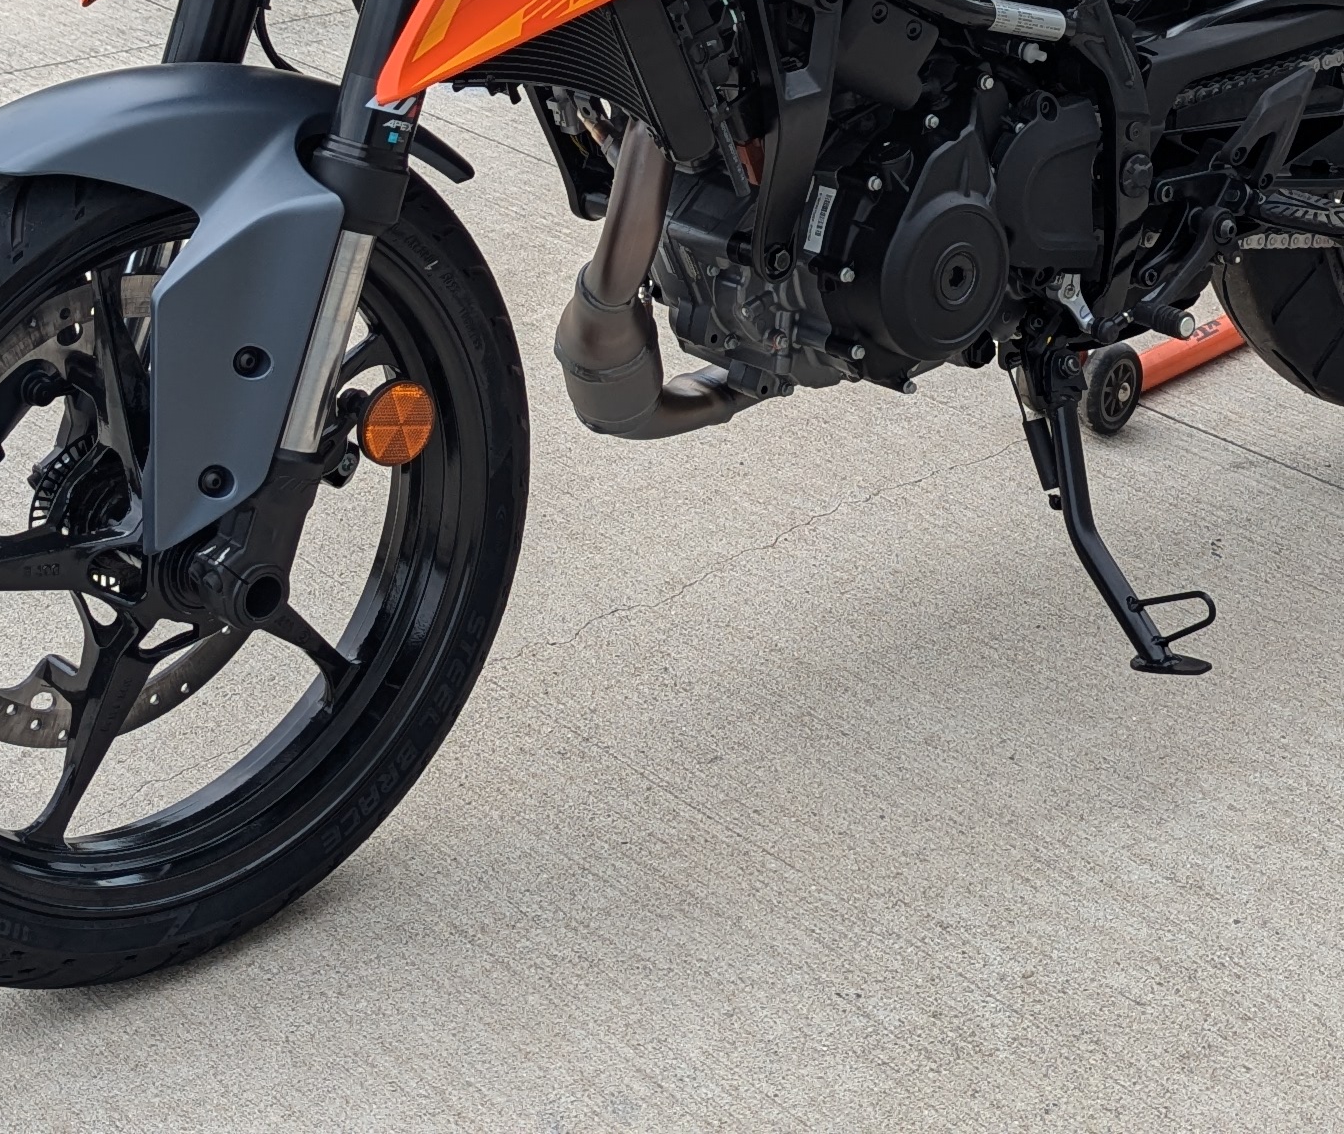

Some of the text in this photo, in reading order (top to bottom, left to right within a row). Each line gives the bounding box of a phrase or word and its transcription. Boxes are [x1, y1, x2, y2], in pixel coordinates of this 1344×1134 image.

[383, 119, 413, 133] APEX
[320, 611, 485, 855] STEEL BRACE
